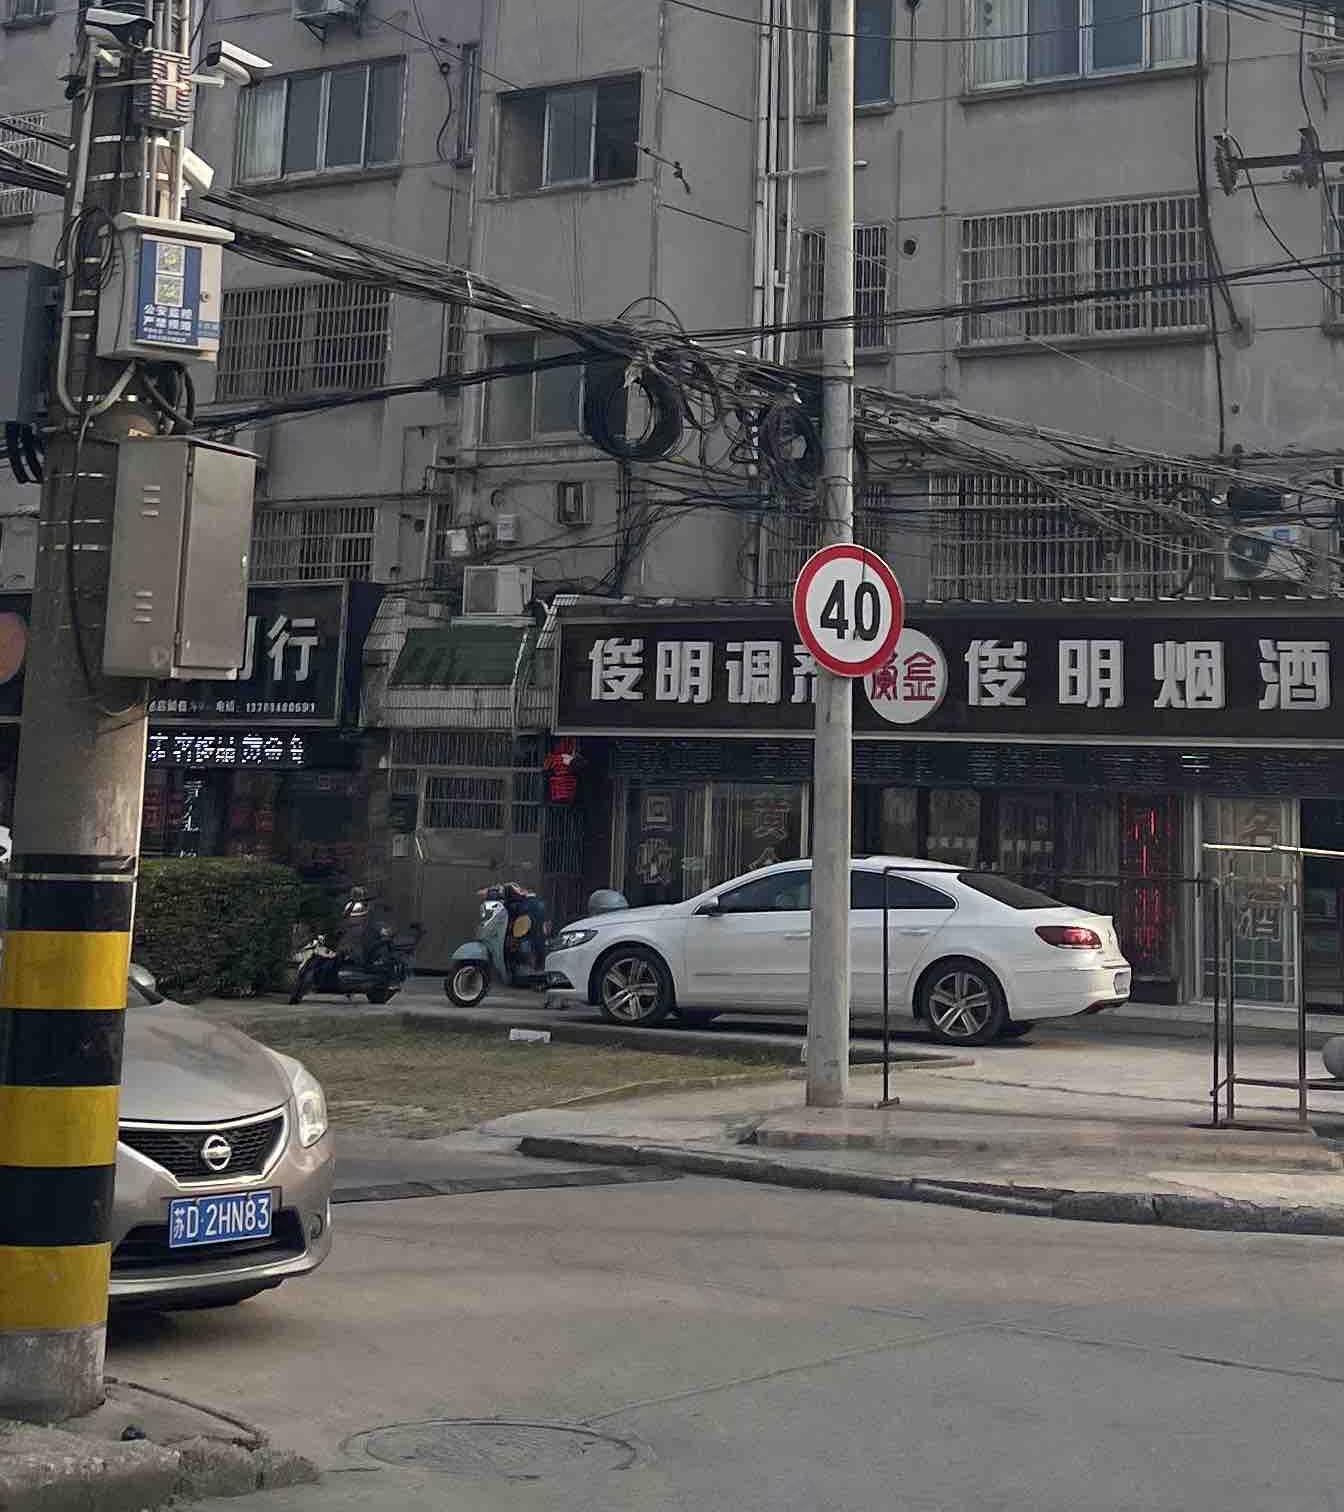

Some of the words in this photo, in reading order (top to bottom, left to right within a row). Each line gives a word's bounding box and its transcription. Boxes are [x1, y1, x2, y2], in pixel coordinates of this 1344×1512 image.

[819, 578, 882, 641] 40
[964, 638, 1332, 711] 俊明烟酒
